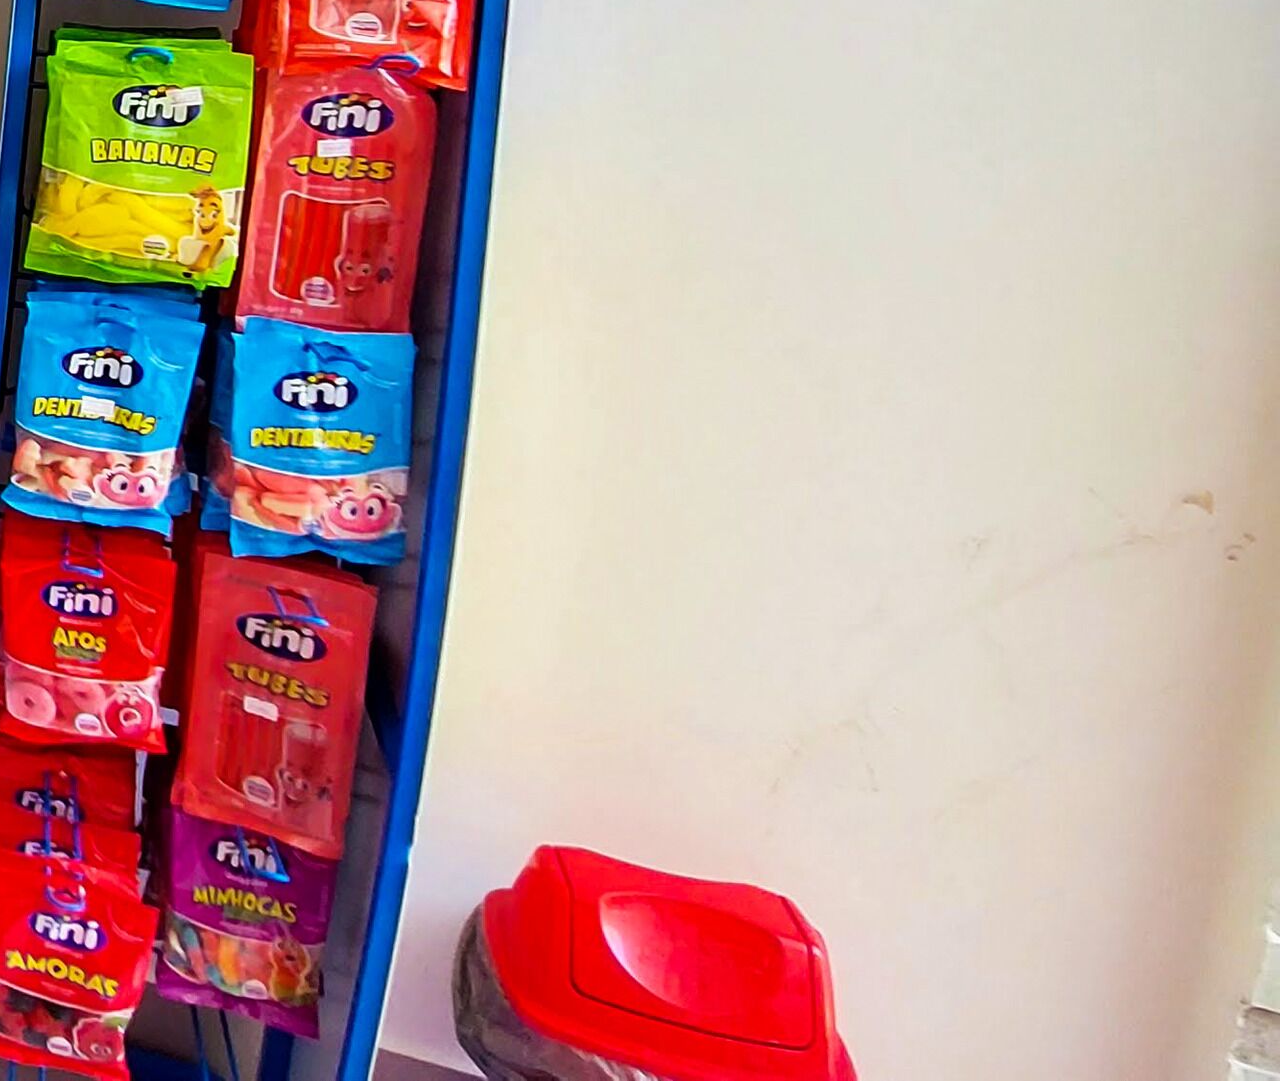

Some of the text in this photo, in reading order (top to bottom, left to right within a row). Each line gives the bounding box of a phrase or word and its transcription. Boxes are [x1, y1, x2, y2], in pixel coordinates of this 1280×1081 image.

[310, 97, 381, 133] Fini
[90, 138, 218, 174] BANANAS
[288, 155, 396, 181] TUBES
[68, 352, 134, 387] Fini
[282, 377, 349, 410] Fini
[48, 584, 114, 617] Fini
[244, 617, 316, 661] Fini
[228, 661, 331, 708] TUBES
[192, 885, 298, 923] MINHOCAS
[35, 914, 99, 949] Fini
[5, 949, 120, 999] AMORAS
